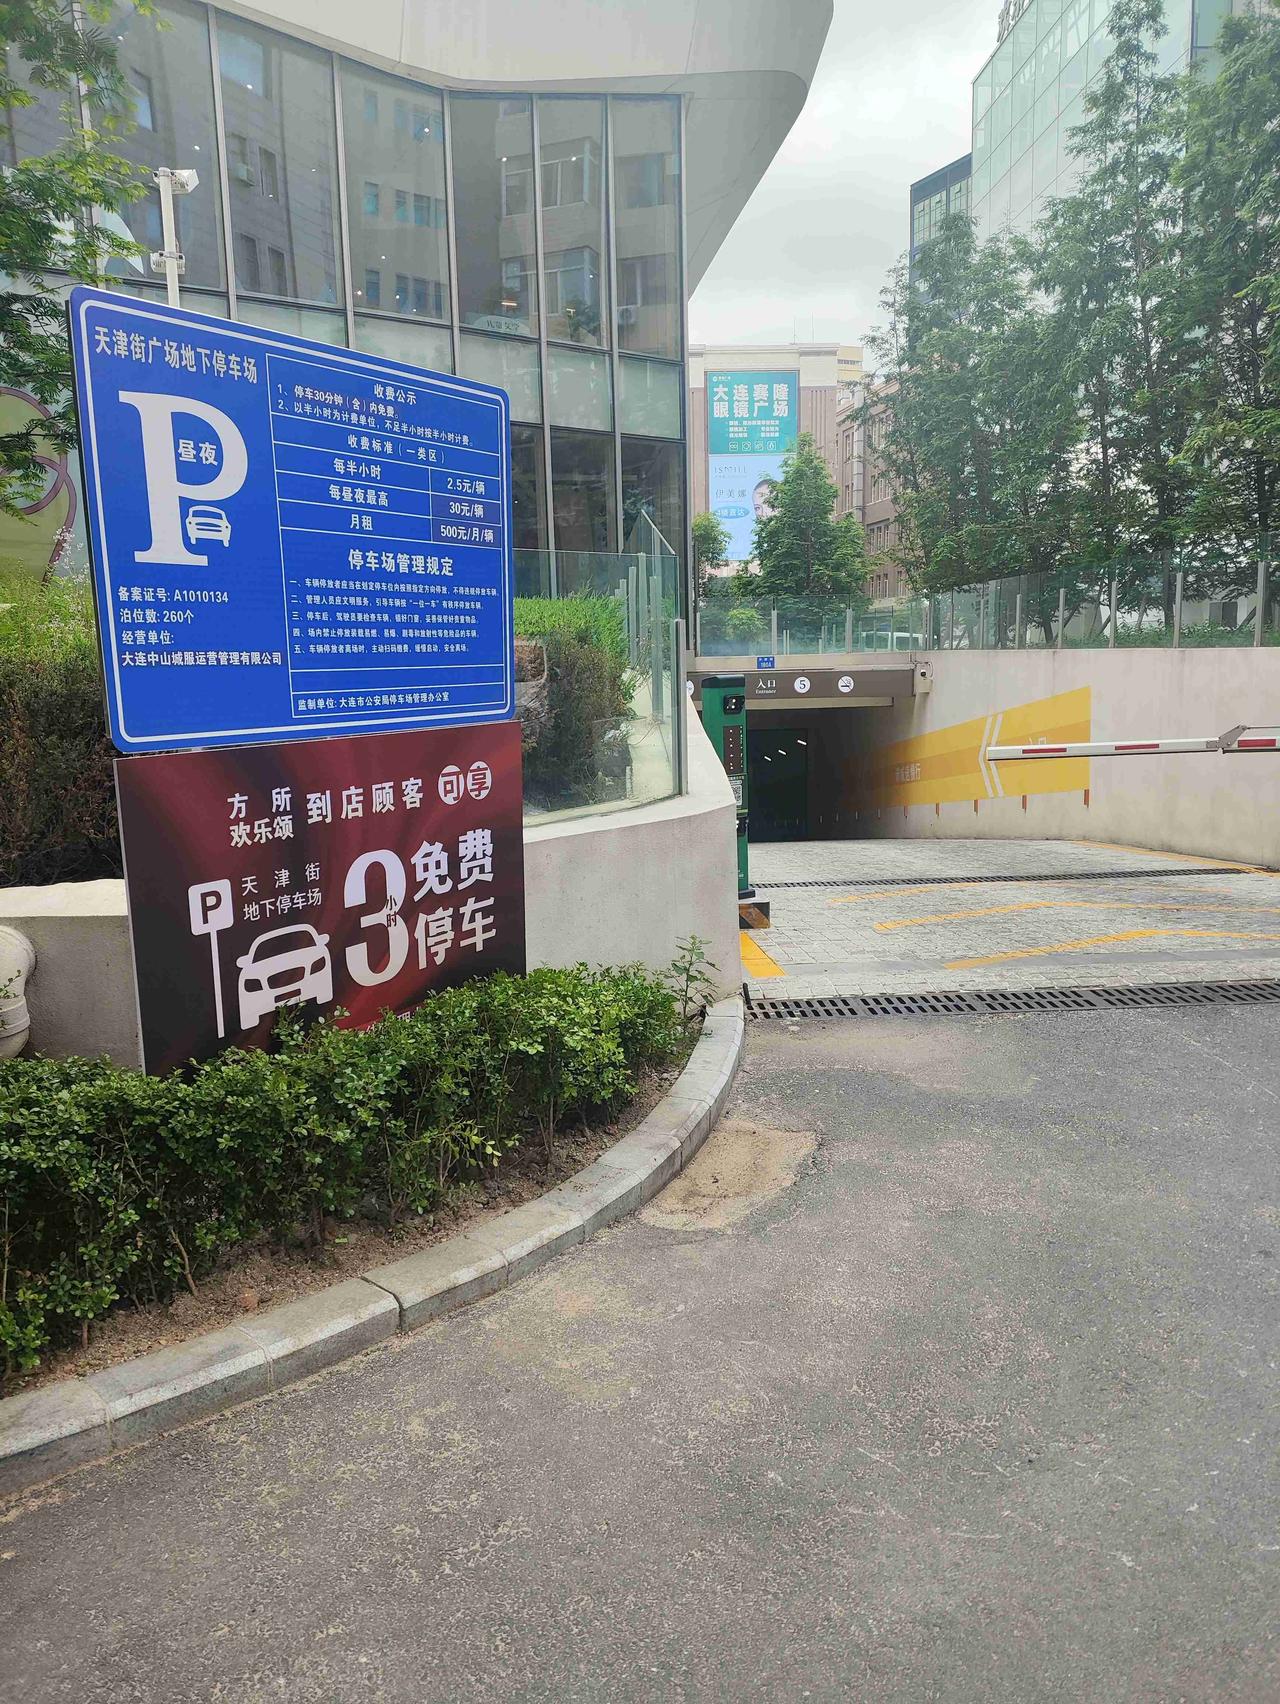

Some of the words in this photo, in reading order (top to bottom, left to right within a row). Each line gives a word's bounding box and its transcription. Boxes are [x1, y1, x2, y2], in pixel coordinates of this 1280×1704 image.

[95, 326, 258, 383] 天津街广场地下停车场
[374, 383, 417, 406] 收费公示
[713, 383, 789, 401] 大连赛隆
[713, 401, 789, 418] 眼镜广场
[178, 439, 218, 466] 昼夜
[118, 390, 248, 567] P
[333, 458, 382, 480] 每半小时
[329, 484, 389, 507] 每昼夜最高
[447, 477, 485, 495] 2.5元/辆
[350, 514, 373, 531] 月租
[449, 502, 484, 518] 30元/辆
[440, 525, 494, 543] 500元/月/辆
[348, 549, 454, 577] 停车场管理规定
[121, 652, 282, 667] 大连中山城服运营管理有限公司
[756, 678, 776, 689] 入口
[799, 680, 806, 690] 5
[227, 787, 291, 819] 方所
[306, 778, 424, 824] 到店顾客
[438, 763, 491, 802] 可享
[229, 815, 294, 848] 欢乐颂
[410, 828, 494, 901] 免费
[242, 862, 320, 896] 天津街
[200, 890, 222, 925] P
[243, 888, 322, 921] 地下停车场
[343, 849, 409, 987] 3
[386, 895, 397, 927] 小时
[414, 897, 496, 970] 停车
